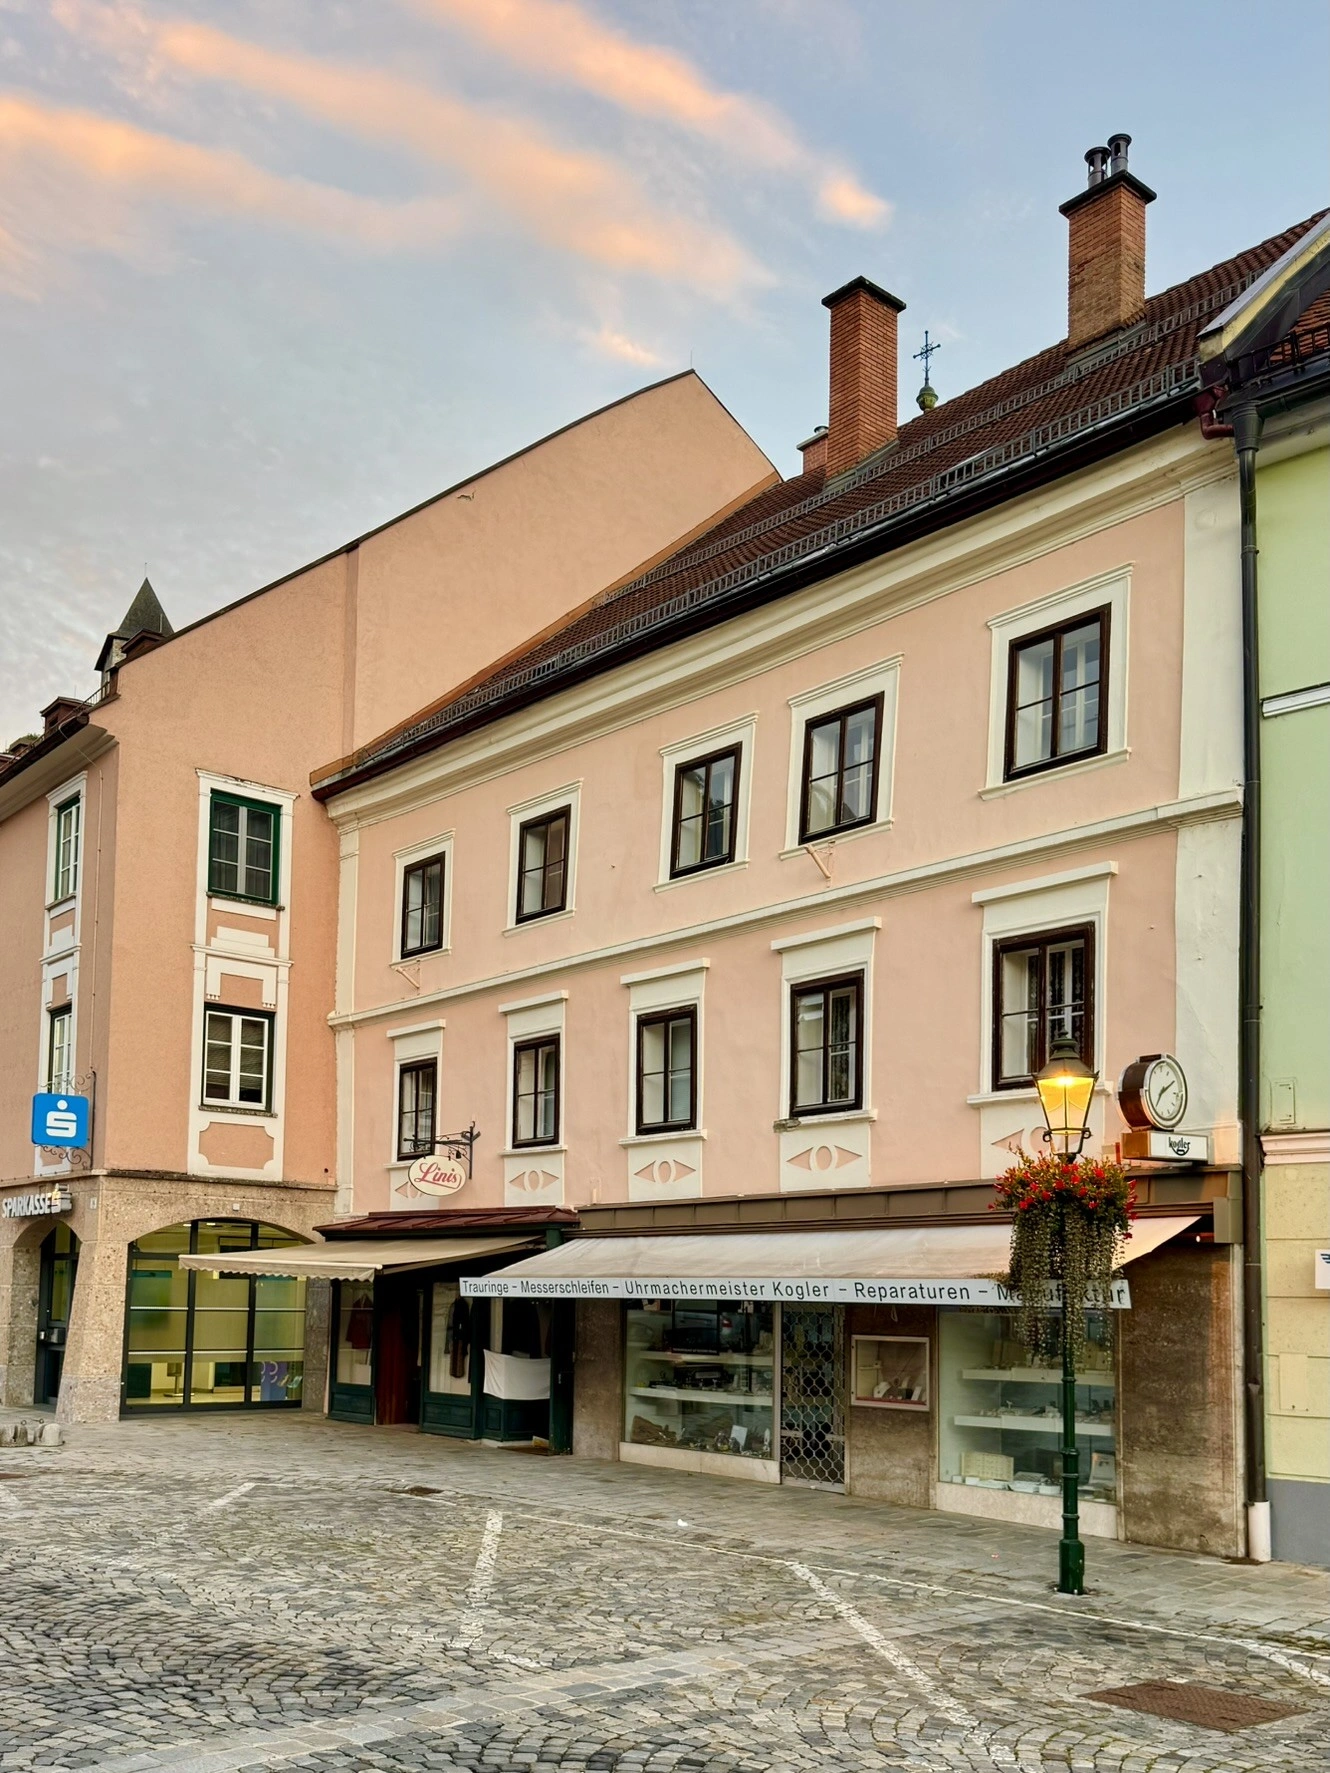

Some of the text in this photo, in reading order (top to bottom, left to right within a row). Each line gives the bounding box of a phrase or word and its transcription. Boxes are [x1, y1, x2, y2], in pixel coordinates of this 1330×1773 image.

[413, 1162, 462, 1190] Linis
[2, 1192, 52, 1218] SPARKASSE
[462, 1280, 509, 1296] Trauringe
[520, 1280, 609, 1295] Messerschleifen
[624, 1280, 765, 1296] Uhrmachermeister
[772, 1281, 829, 1300] Kogler
[854, 1282, 970, 1301] Reparaturen
